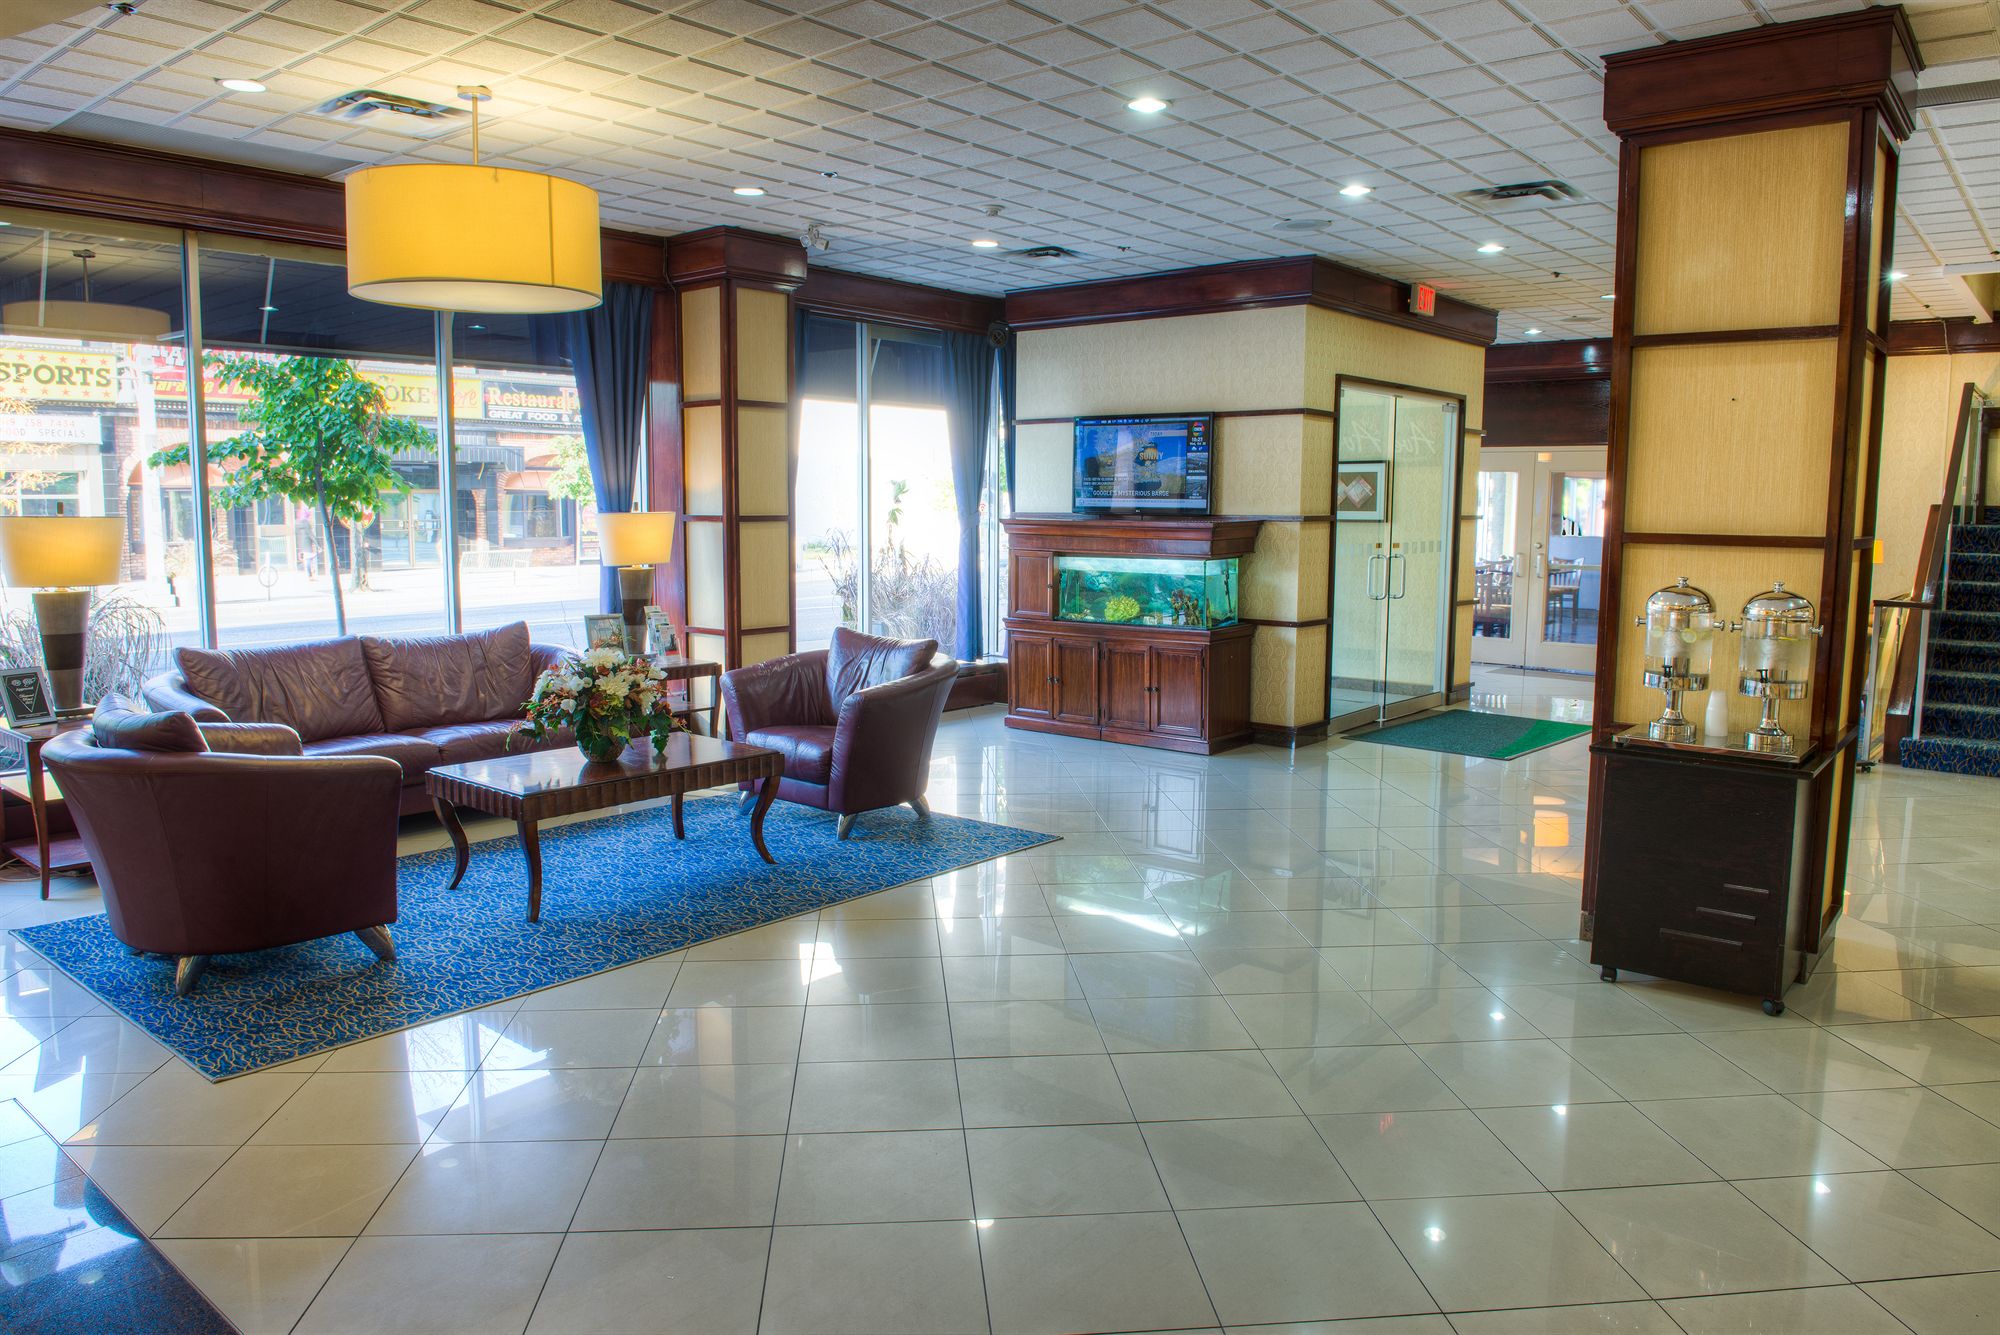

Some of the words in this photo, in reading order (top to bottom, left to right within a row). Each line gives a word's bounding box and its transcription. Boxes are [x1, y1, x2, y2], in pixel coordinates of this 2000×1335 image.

[1418, 287, 1435, 313] EXIT
[0, 362, 113, 387] SPORTS
[488, 409, 524, 421] GREAT
[527, 411, 558, 422] FOOD
[38, 427, 86, 438] SPECIALS
[1139, 451, 1164, 461] SUNNY
